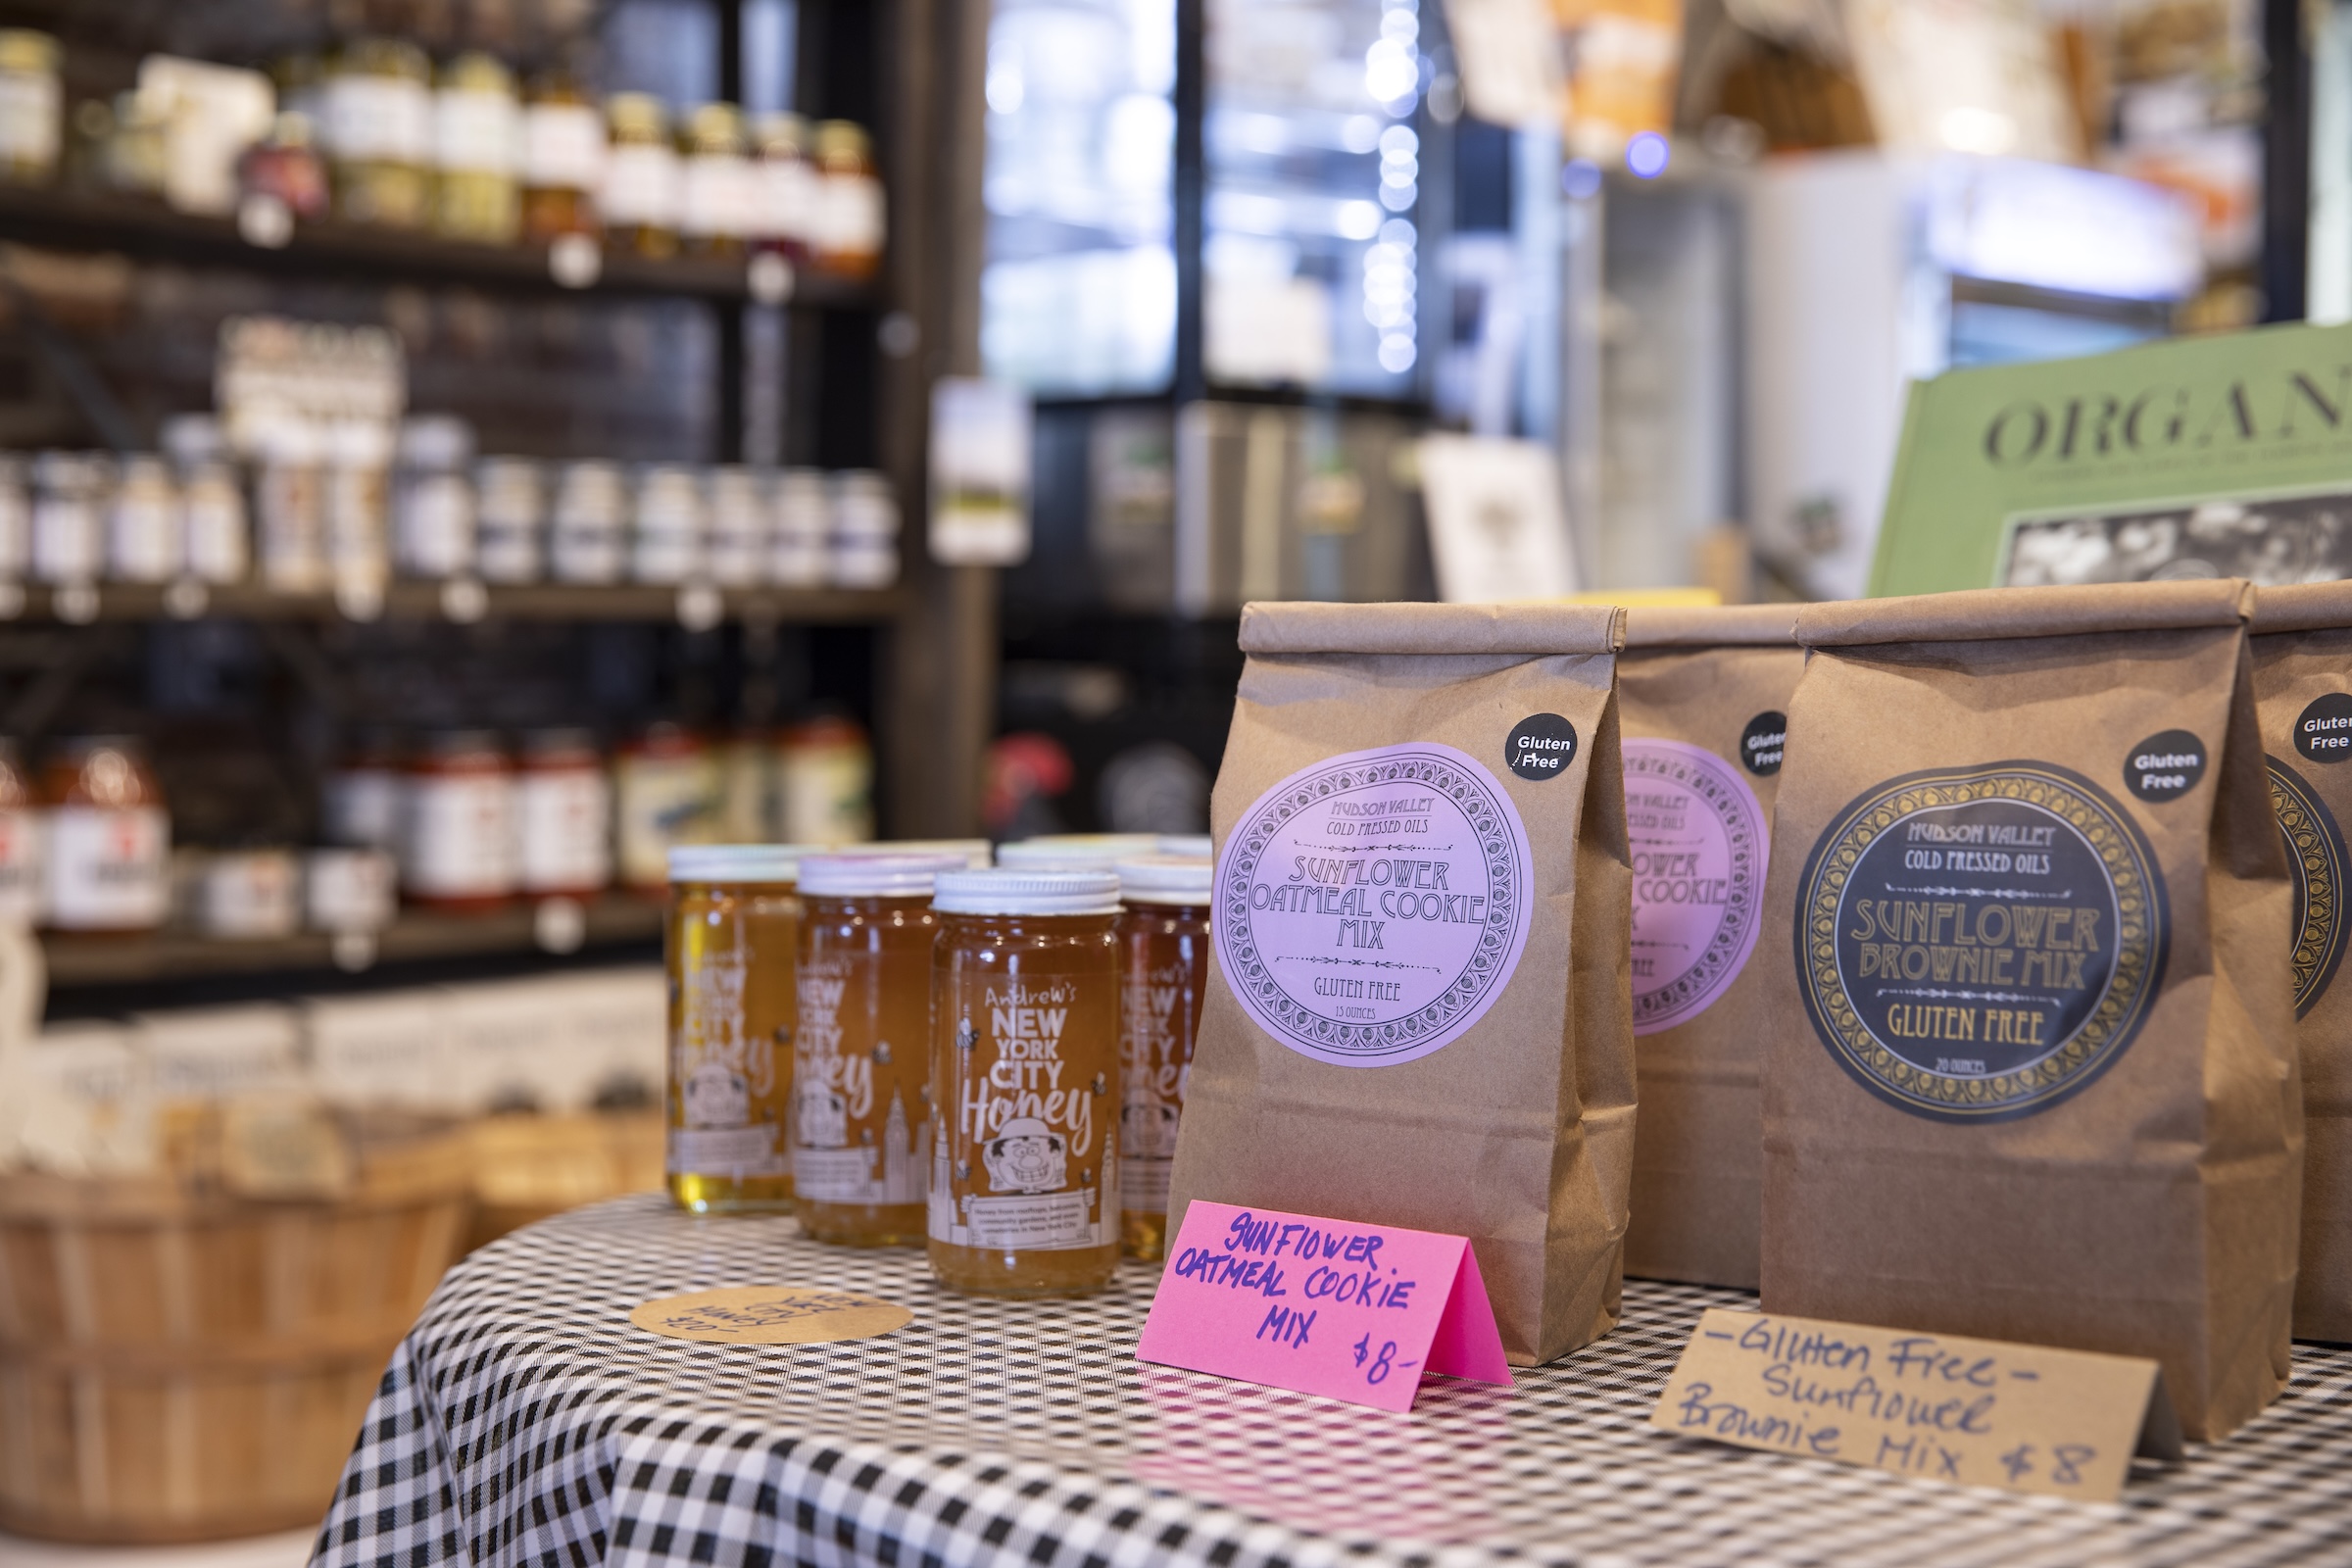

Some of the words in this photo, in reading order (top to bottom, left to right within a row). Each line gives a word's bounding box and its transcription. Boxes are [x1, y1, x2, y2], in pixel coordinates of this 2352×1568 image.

[1517, 736, 1571, 751] Gluten
[2310, 736, 2350, 750] Free
[1522, 755, 1559, 768] Free
[1754, 751, 1784, 766] Free
[2134, 753, 2198, 770] Gluten
[2141, 774, 2186, 790] Free
[1331, 799, 1388, 816] HUDSON
[1389, 797, 1436, 814] VALLEY
[1326, 821, 1355, 837] COLD
[1358, 819, 1401, 836] PRESSED
[1404, 818, 1429, 834] OILS
[1907, 821, 1985, 844] HUDSON
[1987, 824, 2056, 847] VALLEY
[1289, 856, 1450, 891] SUNFLOWER
[1904, 849, 1942, 870] COLD
[1946, 851, 2011, 872] PRESSED
[2015, 854, 2050, 875] OILS
[1250, 884, 1373, 917] OATMEAL
[1380, 890, 1486, 924] COOKIE
[1639, 878, 1728, 906] COOKIE
[1336, 918, 1386, 950] MIX
[1850, 899, 2101, 952] SUNFLOWER
[1859, 942, 2014, 986] BROWNIE
[2020, 950, 2086, 991] MIX
[1314, 977, 1364, 999] GLUTEN
[1367, 982, 1401, 1002] FREE
[992, 1007, 1068, 1039] NEW
[1335, 1005, 1345, 1017] 15
[1346, 1006, 1377, 1020] OUNCES
[1887, 1003, 1976, 1041] GLUTEN
[1984, 1008, 2045, 1046] FREE
[996, 1038, 1059, 1060] YORK
[990, 1059, 1064, 1091] CITY
[1935, 1056, 1949, 1072] 20
[1950, 1057, 1986, 1074] OUNCES
[960, 1076, 1092, 1157] Honey
[1175, 1248, 1287, 1298] OATMEAL
[1256, 1304, 1317, 1349] MIX
[1678, 1382, 1842, 1455] Brownie
[1875, 1434, 1963, 1478] Mix
